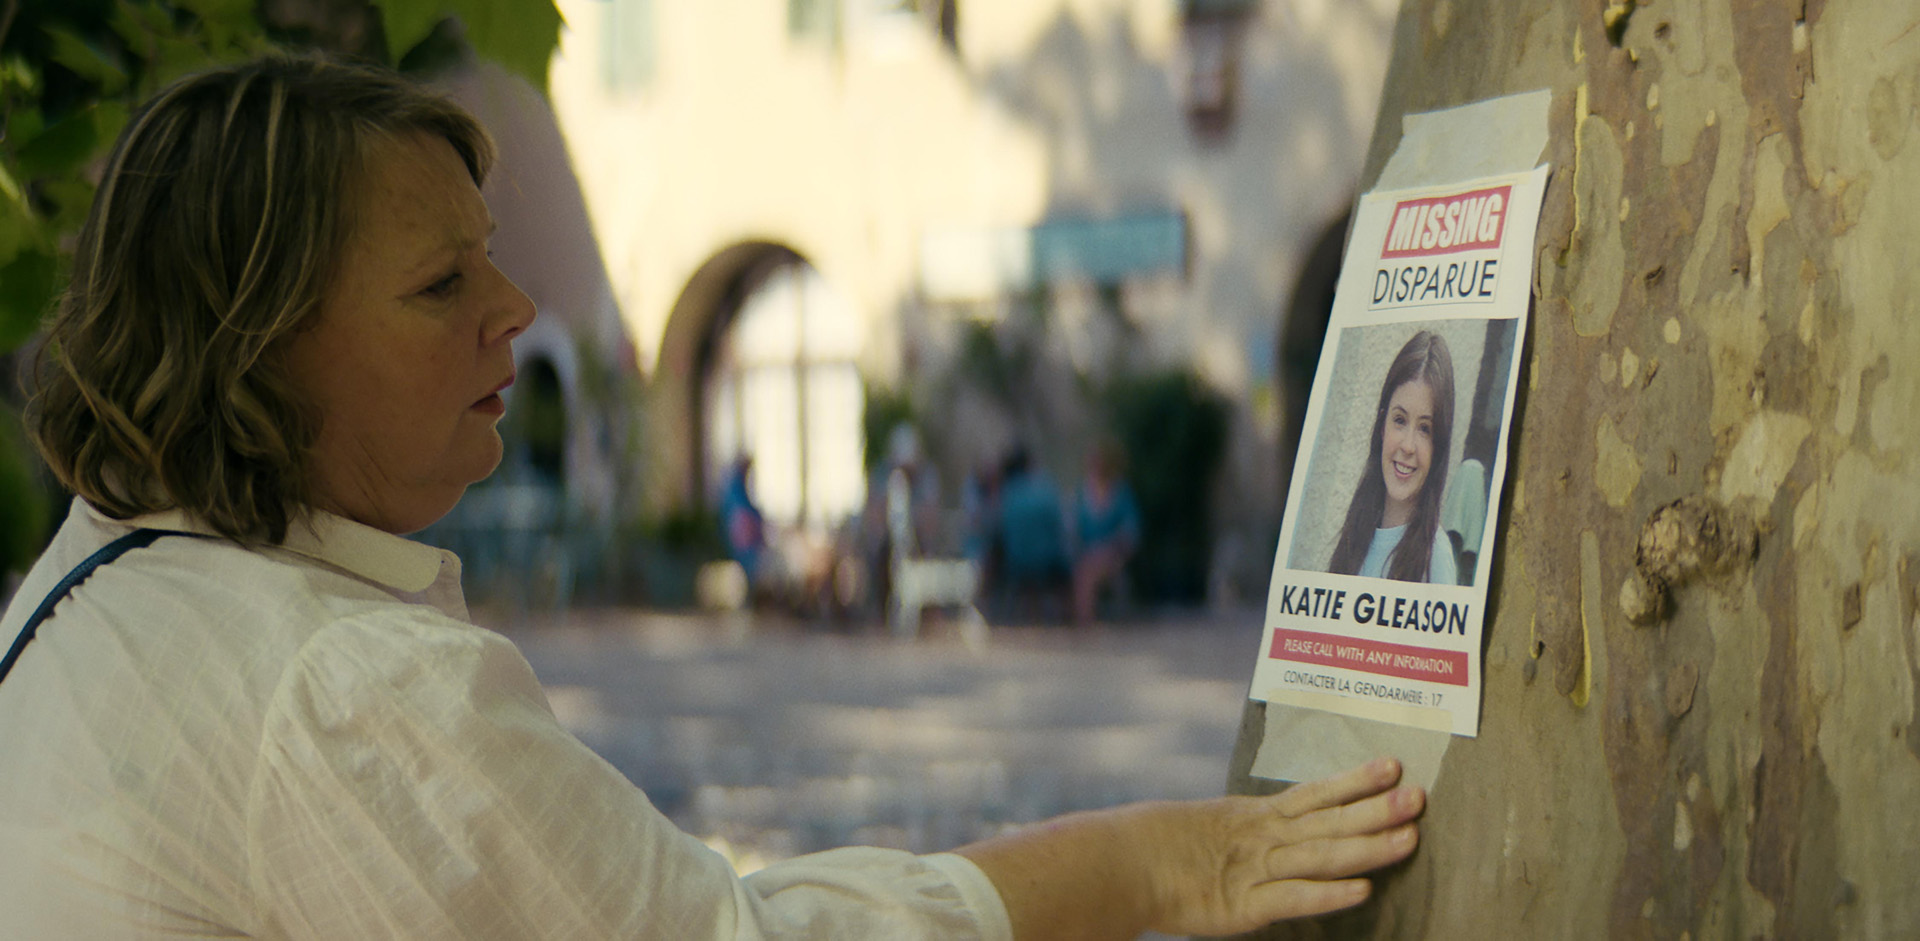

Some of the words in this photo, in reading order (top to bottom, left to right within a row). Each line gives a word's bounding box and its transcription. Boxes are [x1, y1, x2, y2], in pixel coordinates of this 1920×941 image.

[1387, 193, 1503, 251] MISSING
[1372, 259, 1498, 304] DISPARUE
[1280, 585, 1346, 620] KATIE
[1353, 593, 1469, 635] GLEASON
[1284, 638, 1312, 655] PLEASE
[1313, 641, 1333, 657] CALL
[1336, 645, 1365, 662] WITH
[1366, 650, 1392, 667] ANY
[1393, 655, 1453, 674] INFORMATION
[1284, 670, 1336, 690] CONTACTER
[1338, 678, 1350, 691] LA
[1354, 681, 1422, 705] GENDARMERIE
[1431, 693, 1443, 706] 17
